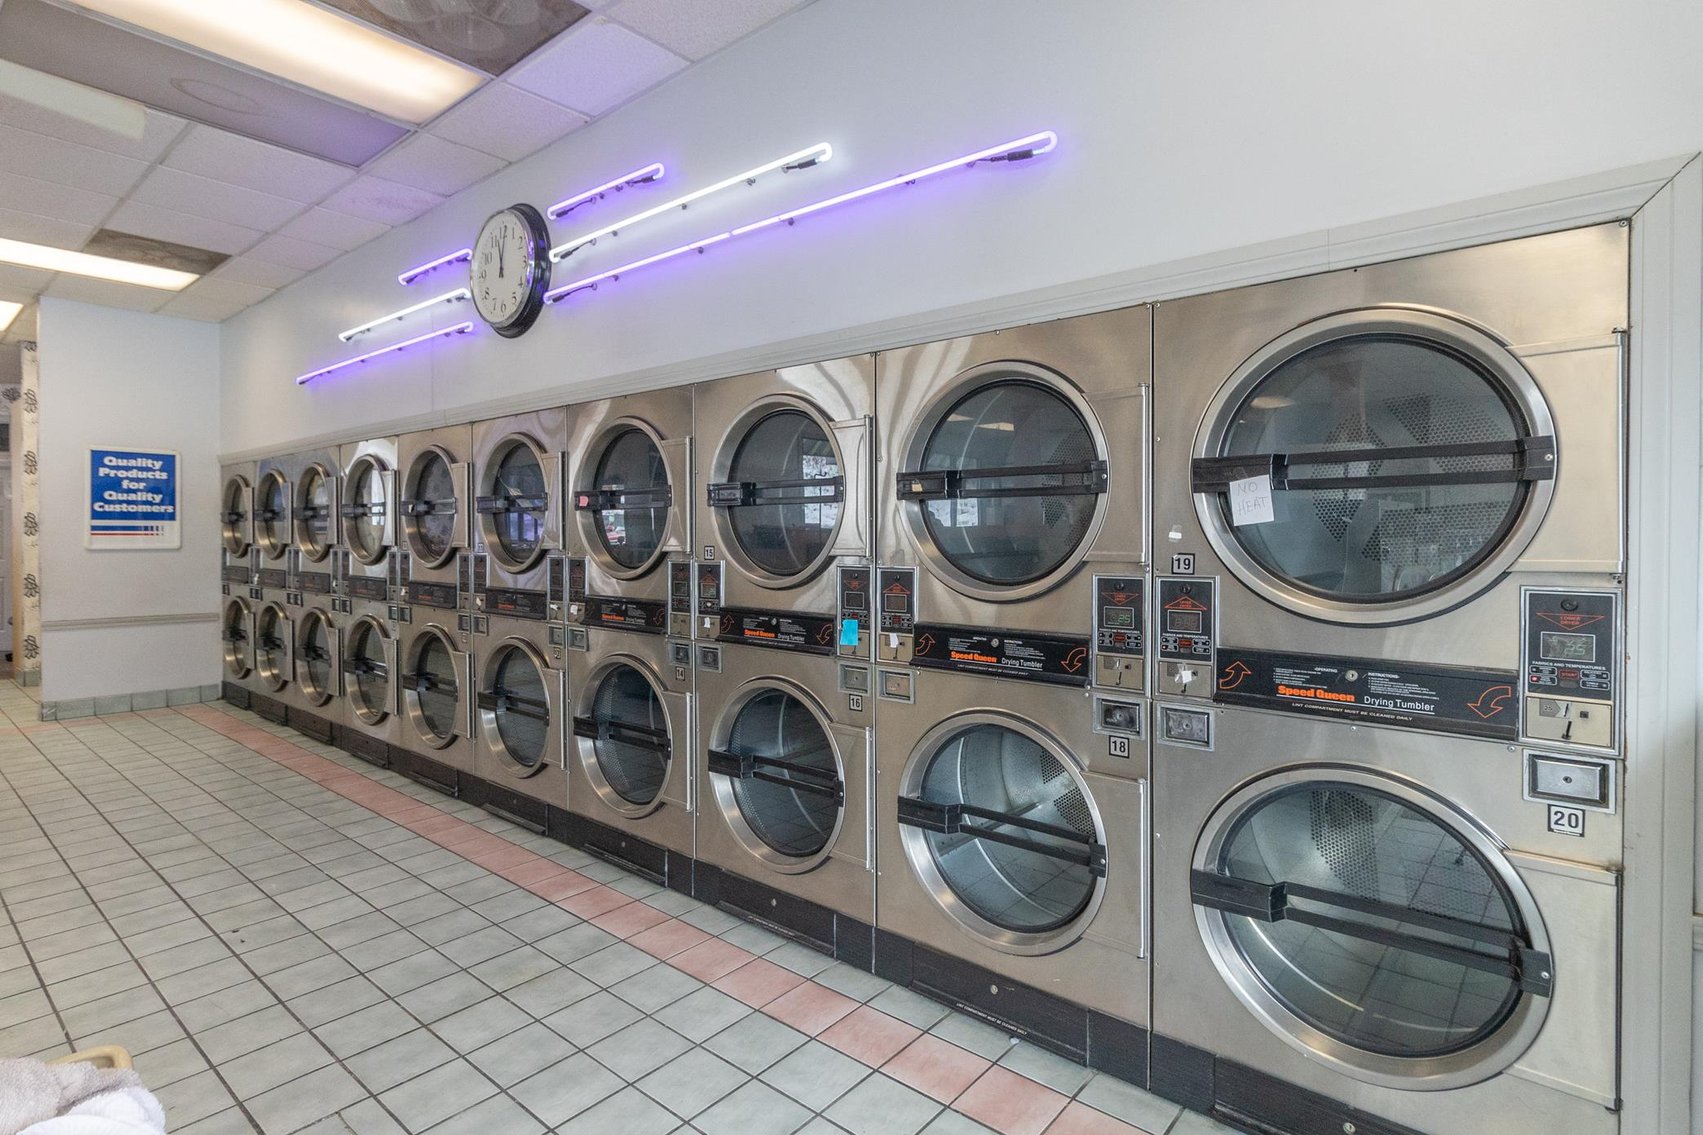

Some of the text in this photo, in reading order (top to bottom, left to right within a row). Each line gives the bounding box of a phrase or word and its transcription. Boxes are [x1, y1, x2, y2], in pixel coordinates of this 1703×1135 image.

[103, 456, 163, 470] Quality
[98, 467, 168, 479] Products
[121, 480, 146, 489] for
[1237, 482, 1258, 496] NO
[103, 491, 163, 503] Quality
[93, 502, 174, 513] Customers
[1238, 497, 1268, 516] HEAT
[1175, 557, 1191, 570] 19
[951, 650, 1043, 669] Speed Queen Drying Tumbler
[850, 697, 861, 708] 16
[1278, 685, 1435, 711] Speed Queen Drying Tumbler
[1111, 739, 1127, 753] 18
[1553, 810, 1580, 829] 20
